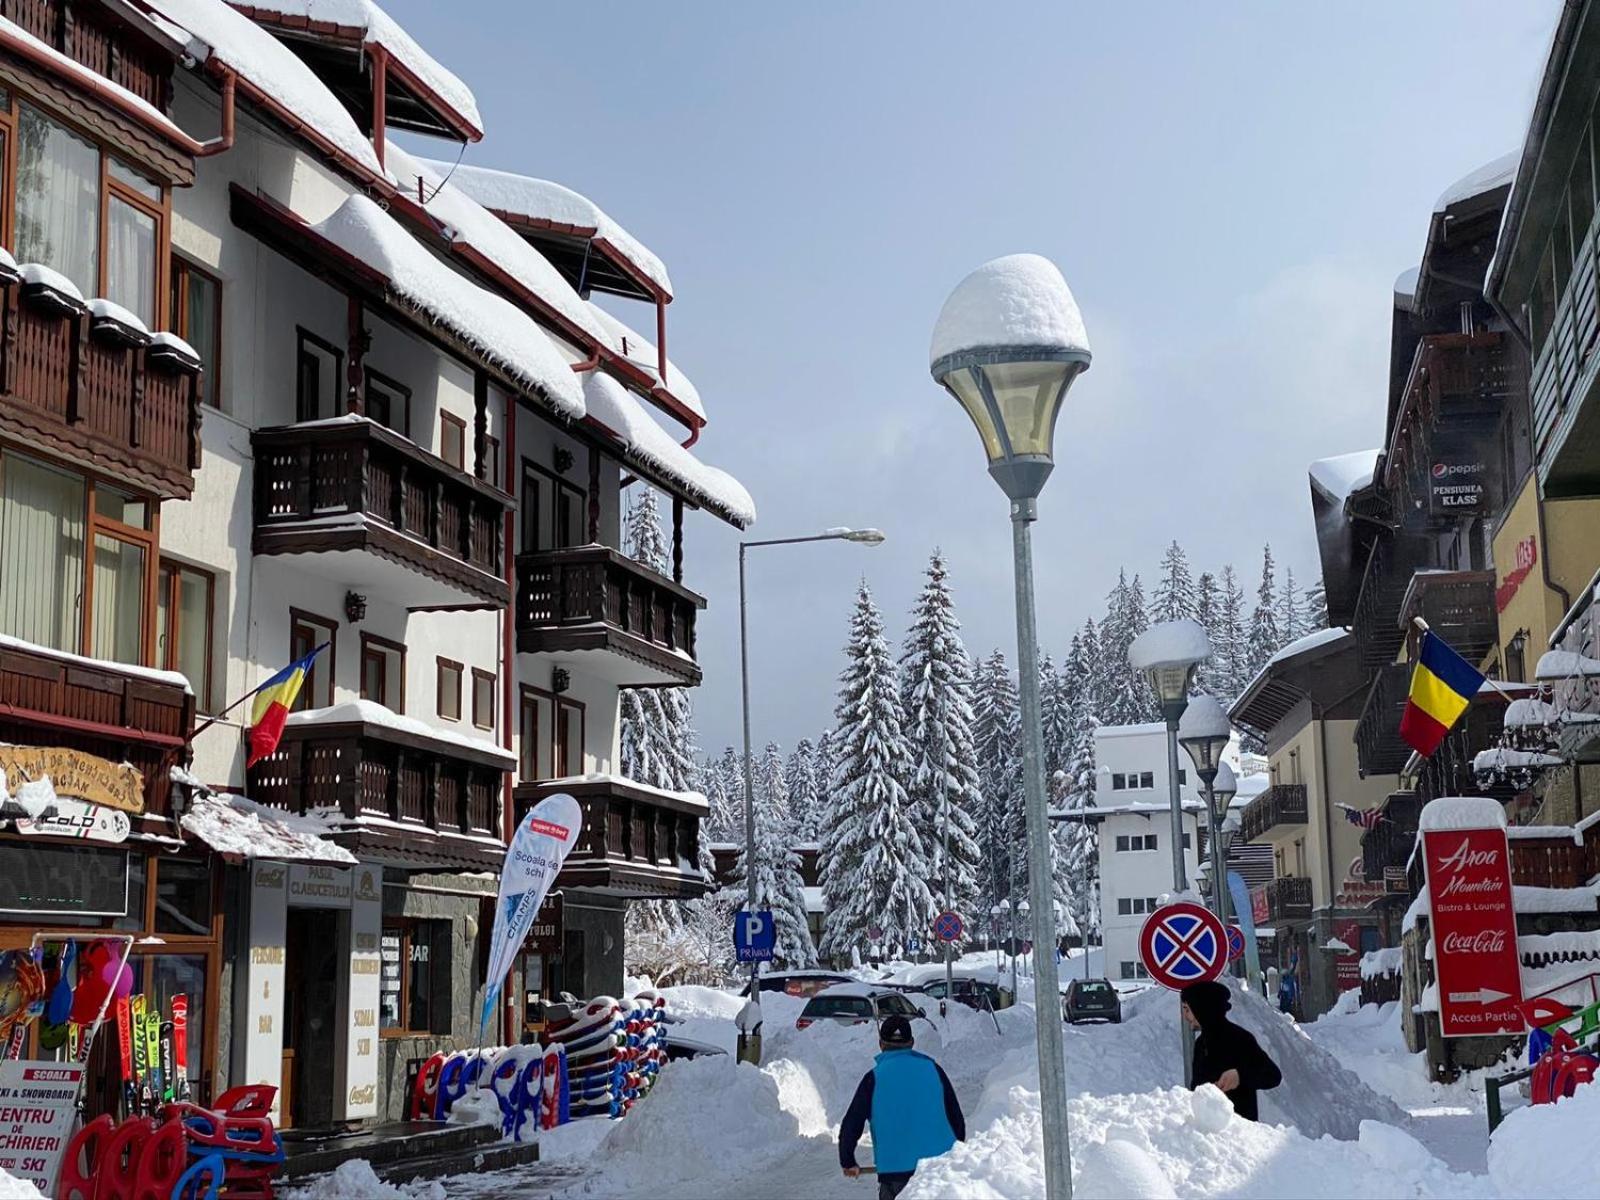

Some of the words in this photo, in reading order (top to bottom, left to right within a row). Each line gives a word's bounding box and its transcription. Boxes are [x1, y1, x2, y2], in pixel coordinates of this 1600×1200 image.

[1449, 463, 1480, 475] pepsi
[1433, 485, 1483, 495] PENSIUNEA
[1442, 495, 1478, 506] KLASS
[515, 850, 546, 867] Scoala
[1436, 837, 1499, 873] Aroa
[525, 867, 545, 879] schi
[1438, 875, 1504, 898] Mountain
[507, 887, 537, 940] CHAMPS
[1437, 903, 1463, 913] Bistro
[1465, 903, 1472, 911] &
[1473, 902, 1506, 912] Lounge
[746, 917, 764, 946] P
[1443, 929, 1507, 954] Coca-Cola
[408, 945, 429, 962] BAR
[1450, 1013, 1482, 1023] Acces
[1485, 1011, 1517, 1022] Partie
[163, 1038, 171, 1080] HEAD
[32, 1070, 72, 1081] SCOALA
[12, 1089, 19, 1098] &
[20, 1088, 75, 1100] SNOWBOARD
[0, 1107, 56, 1124] ENTRU
[11, 1124, 24, 1134] DE
[0, 1135, 61, 1152] CHIRIERI
[21, 1157, 47, 1172] SKI
